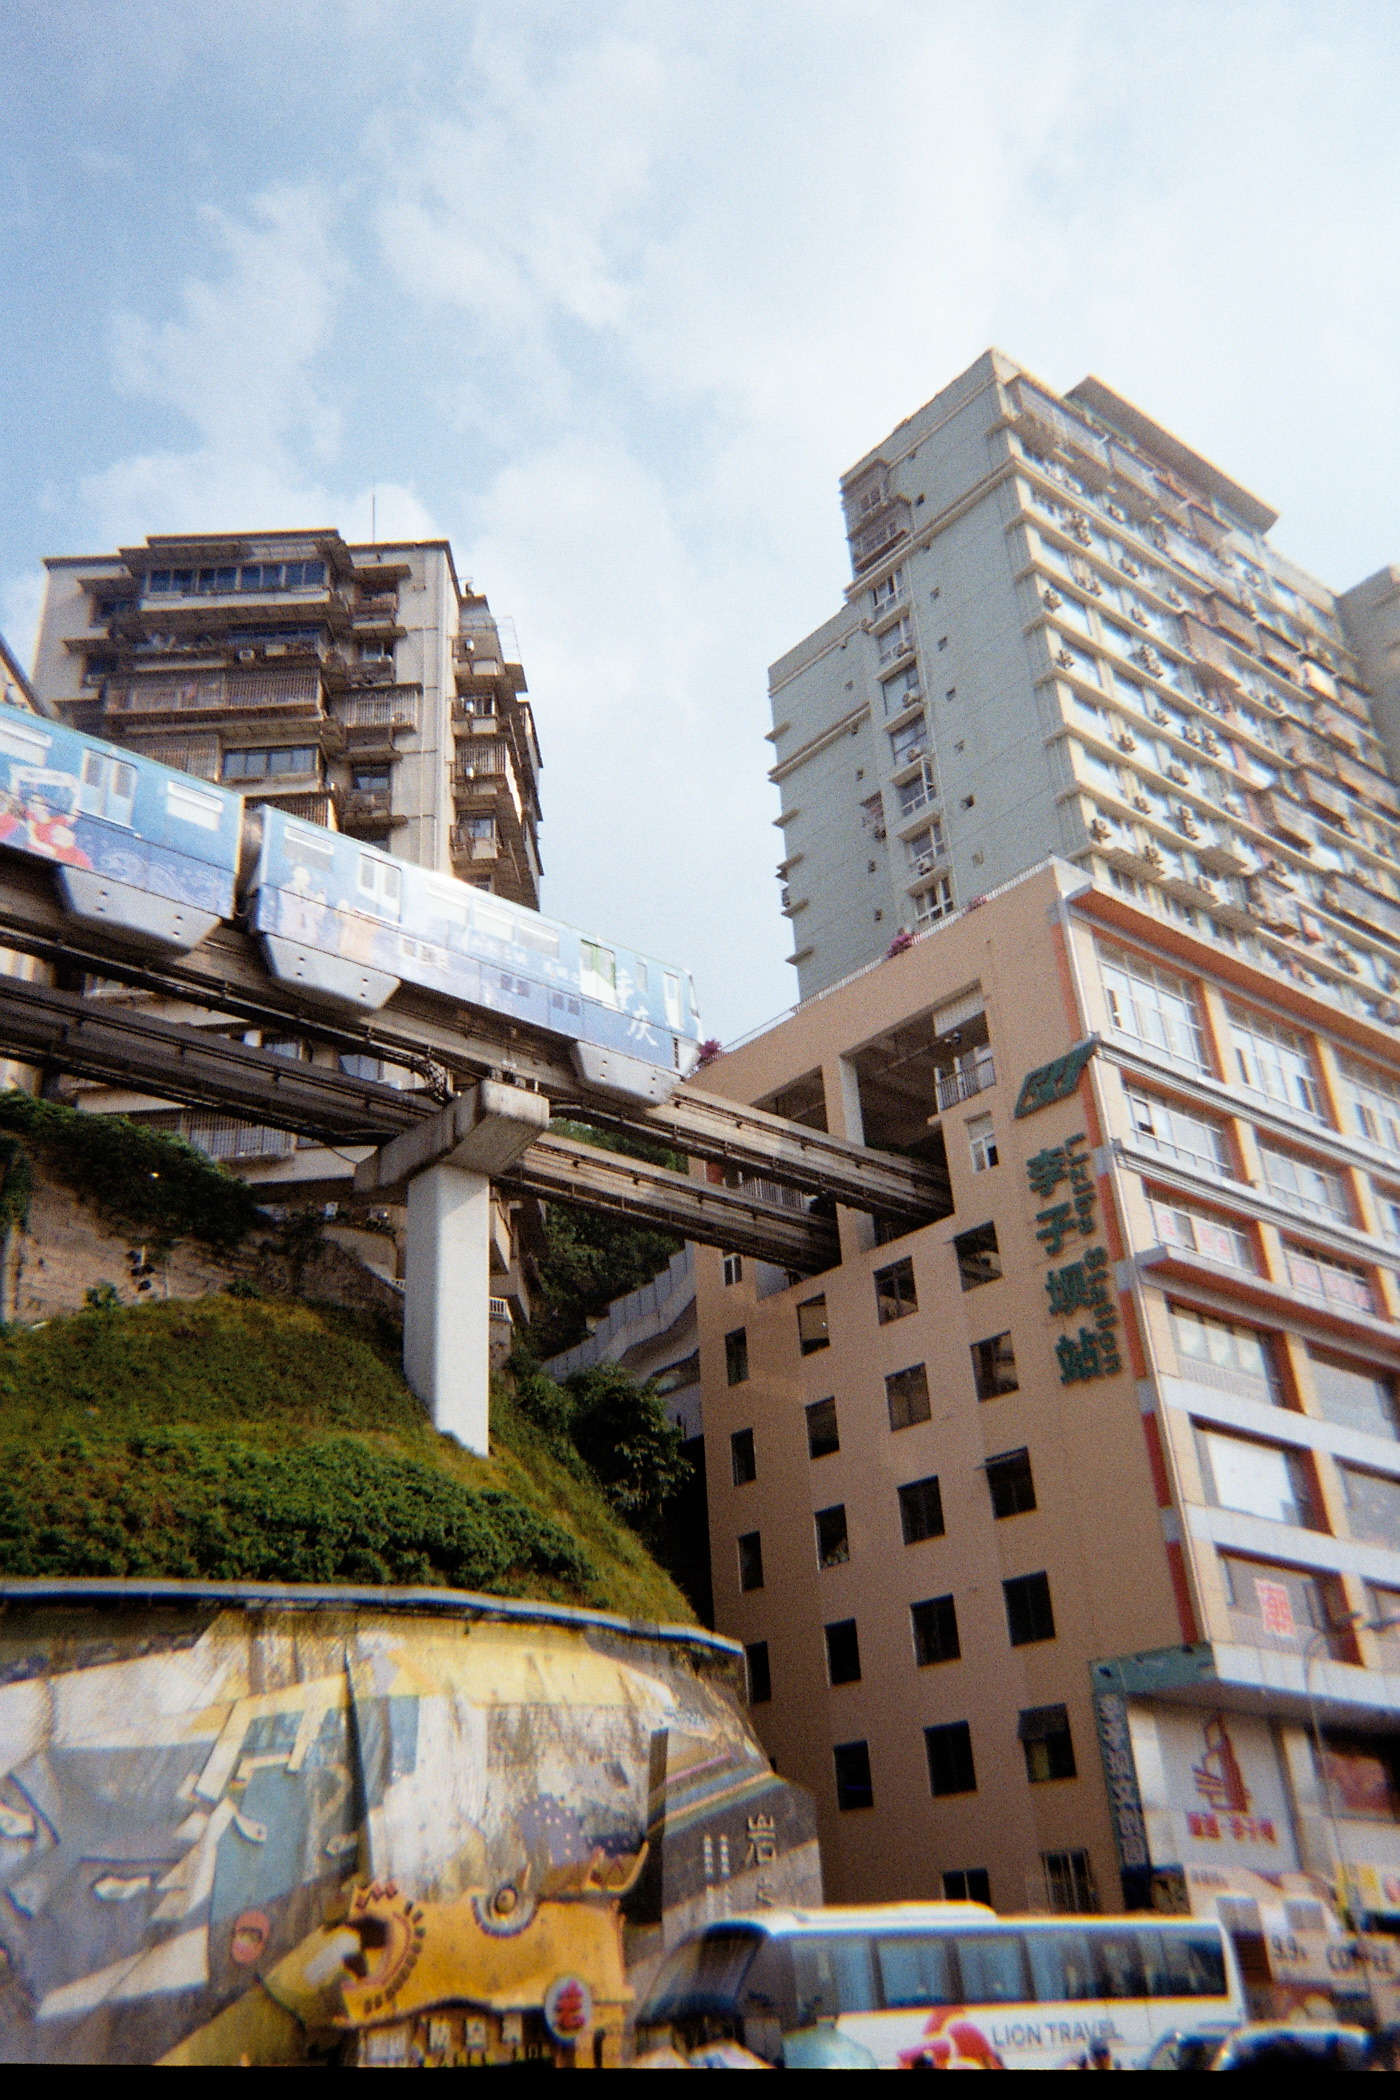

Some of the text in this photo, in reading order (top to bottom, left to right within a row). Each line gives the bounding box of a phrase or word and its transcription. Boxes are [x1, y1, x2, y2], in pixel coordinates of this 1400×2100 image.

[1026, 1148, 1101, 1385] 李子坝站
[1065, 1132, 1121, 1374] Liziba Station
[1326, 1945, 1395, 1974] COEE
[992, 2020, 1125, 2048] LION TRAVEL
